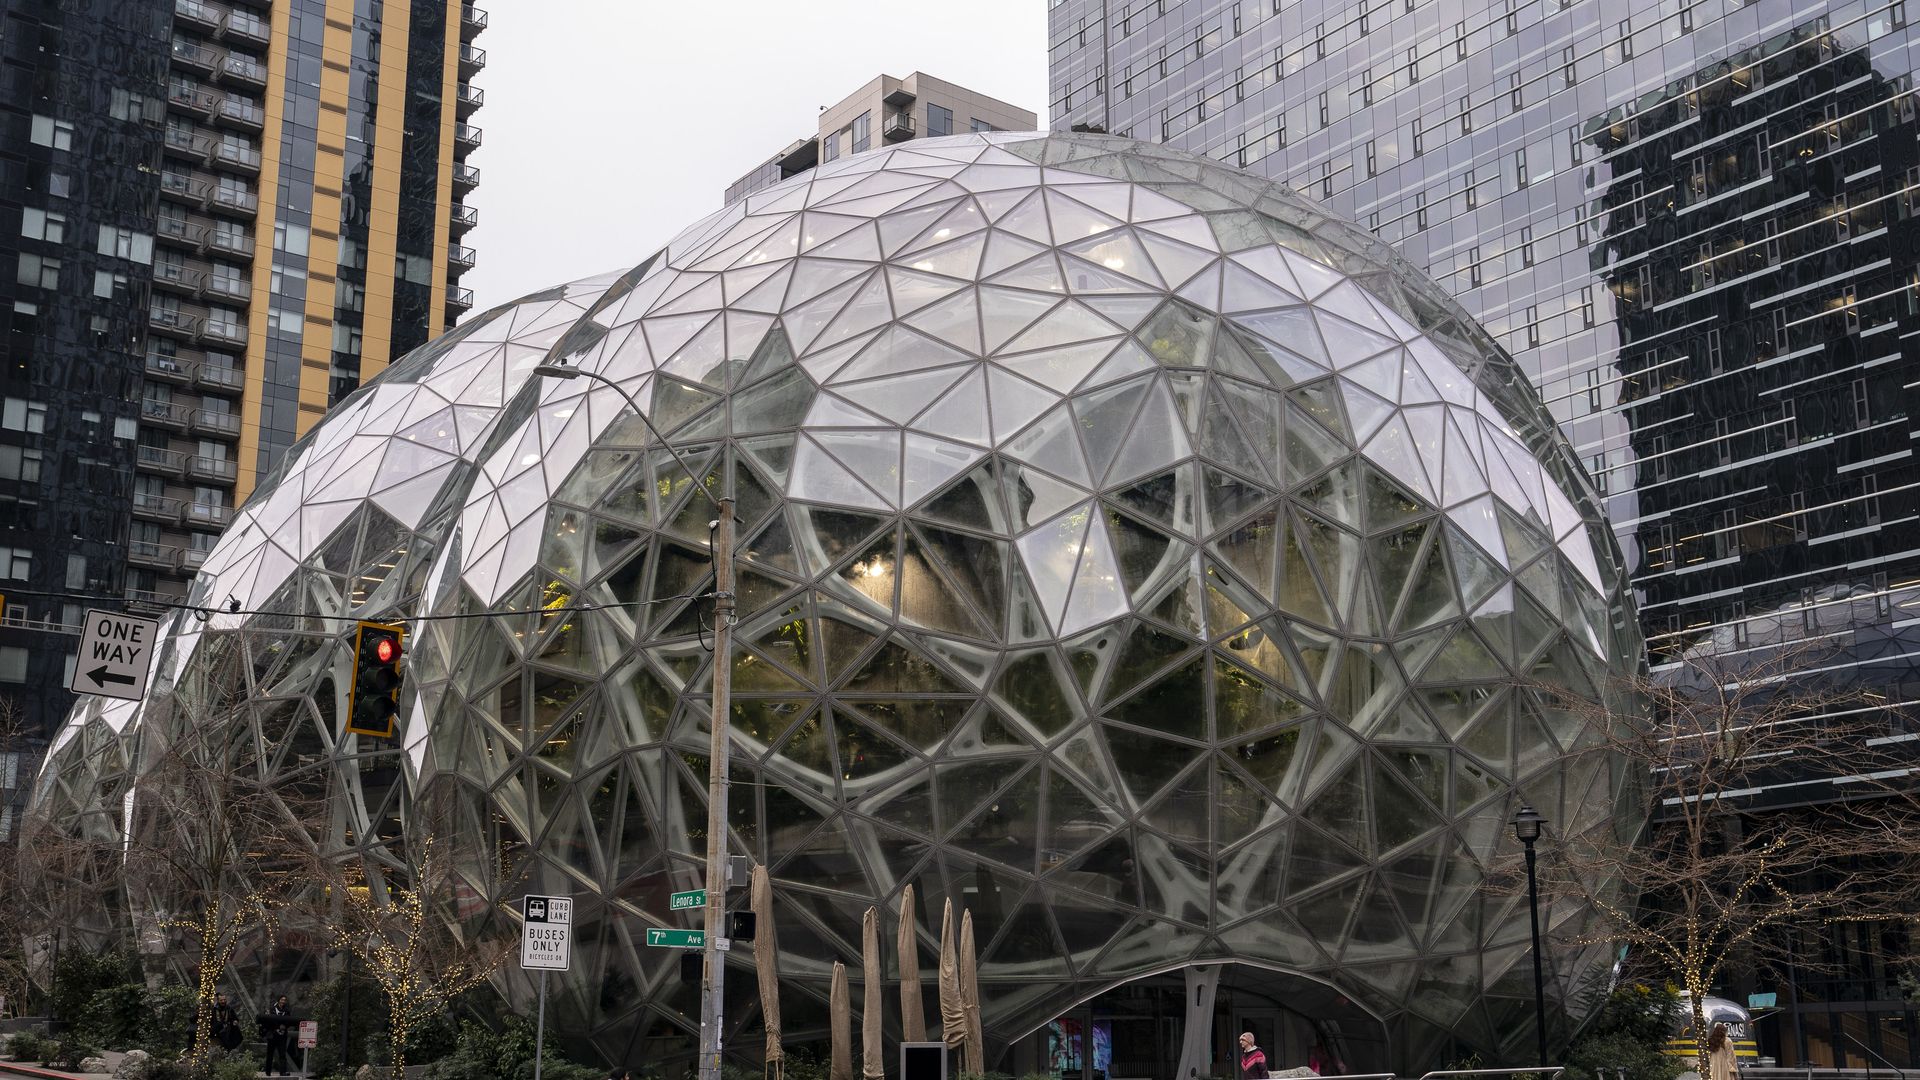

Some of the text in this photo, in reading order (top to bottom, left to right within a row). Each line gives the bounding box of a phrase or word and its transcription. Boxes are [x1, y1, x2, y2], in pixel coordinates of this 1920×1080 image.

[98, 619, 144, 643] ONE
[93, 641, 142, 665] WAY
[550, 902, 569, 911] CURB
[672, 896, 693, 907] Lenora
[550, 912, 567, 920] LANE
[529, 928, 565, 941] BUSES
[651, 931, 702, 944] 7th Ave
[533, 940, 560, 951] ONLY
